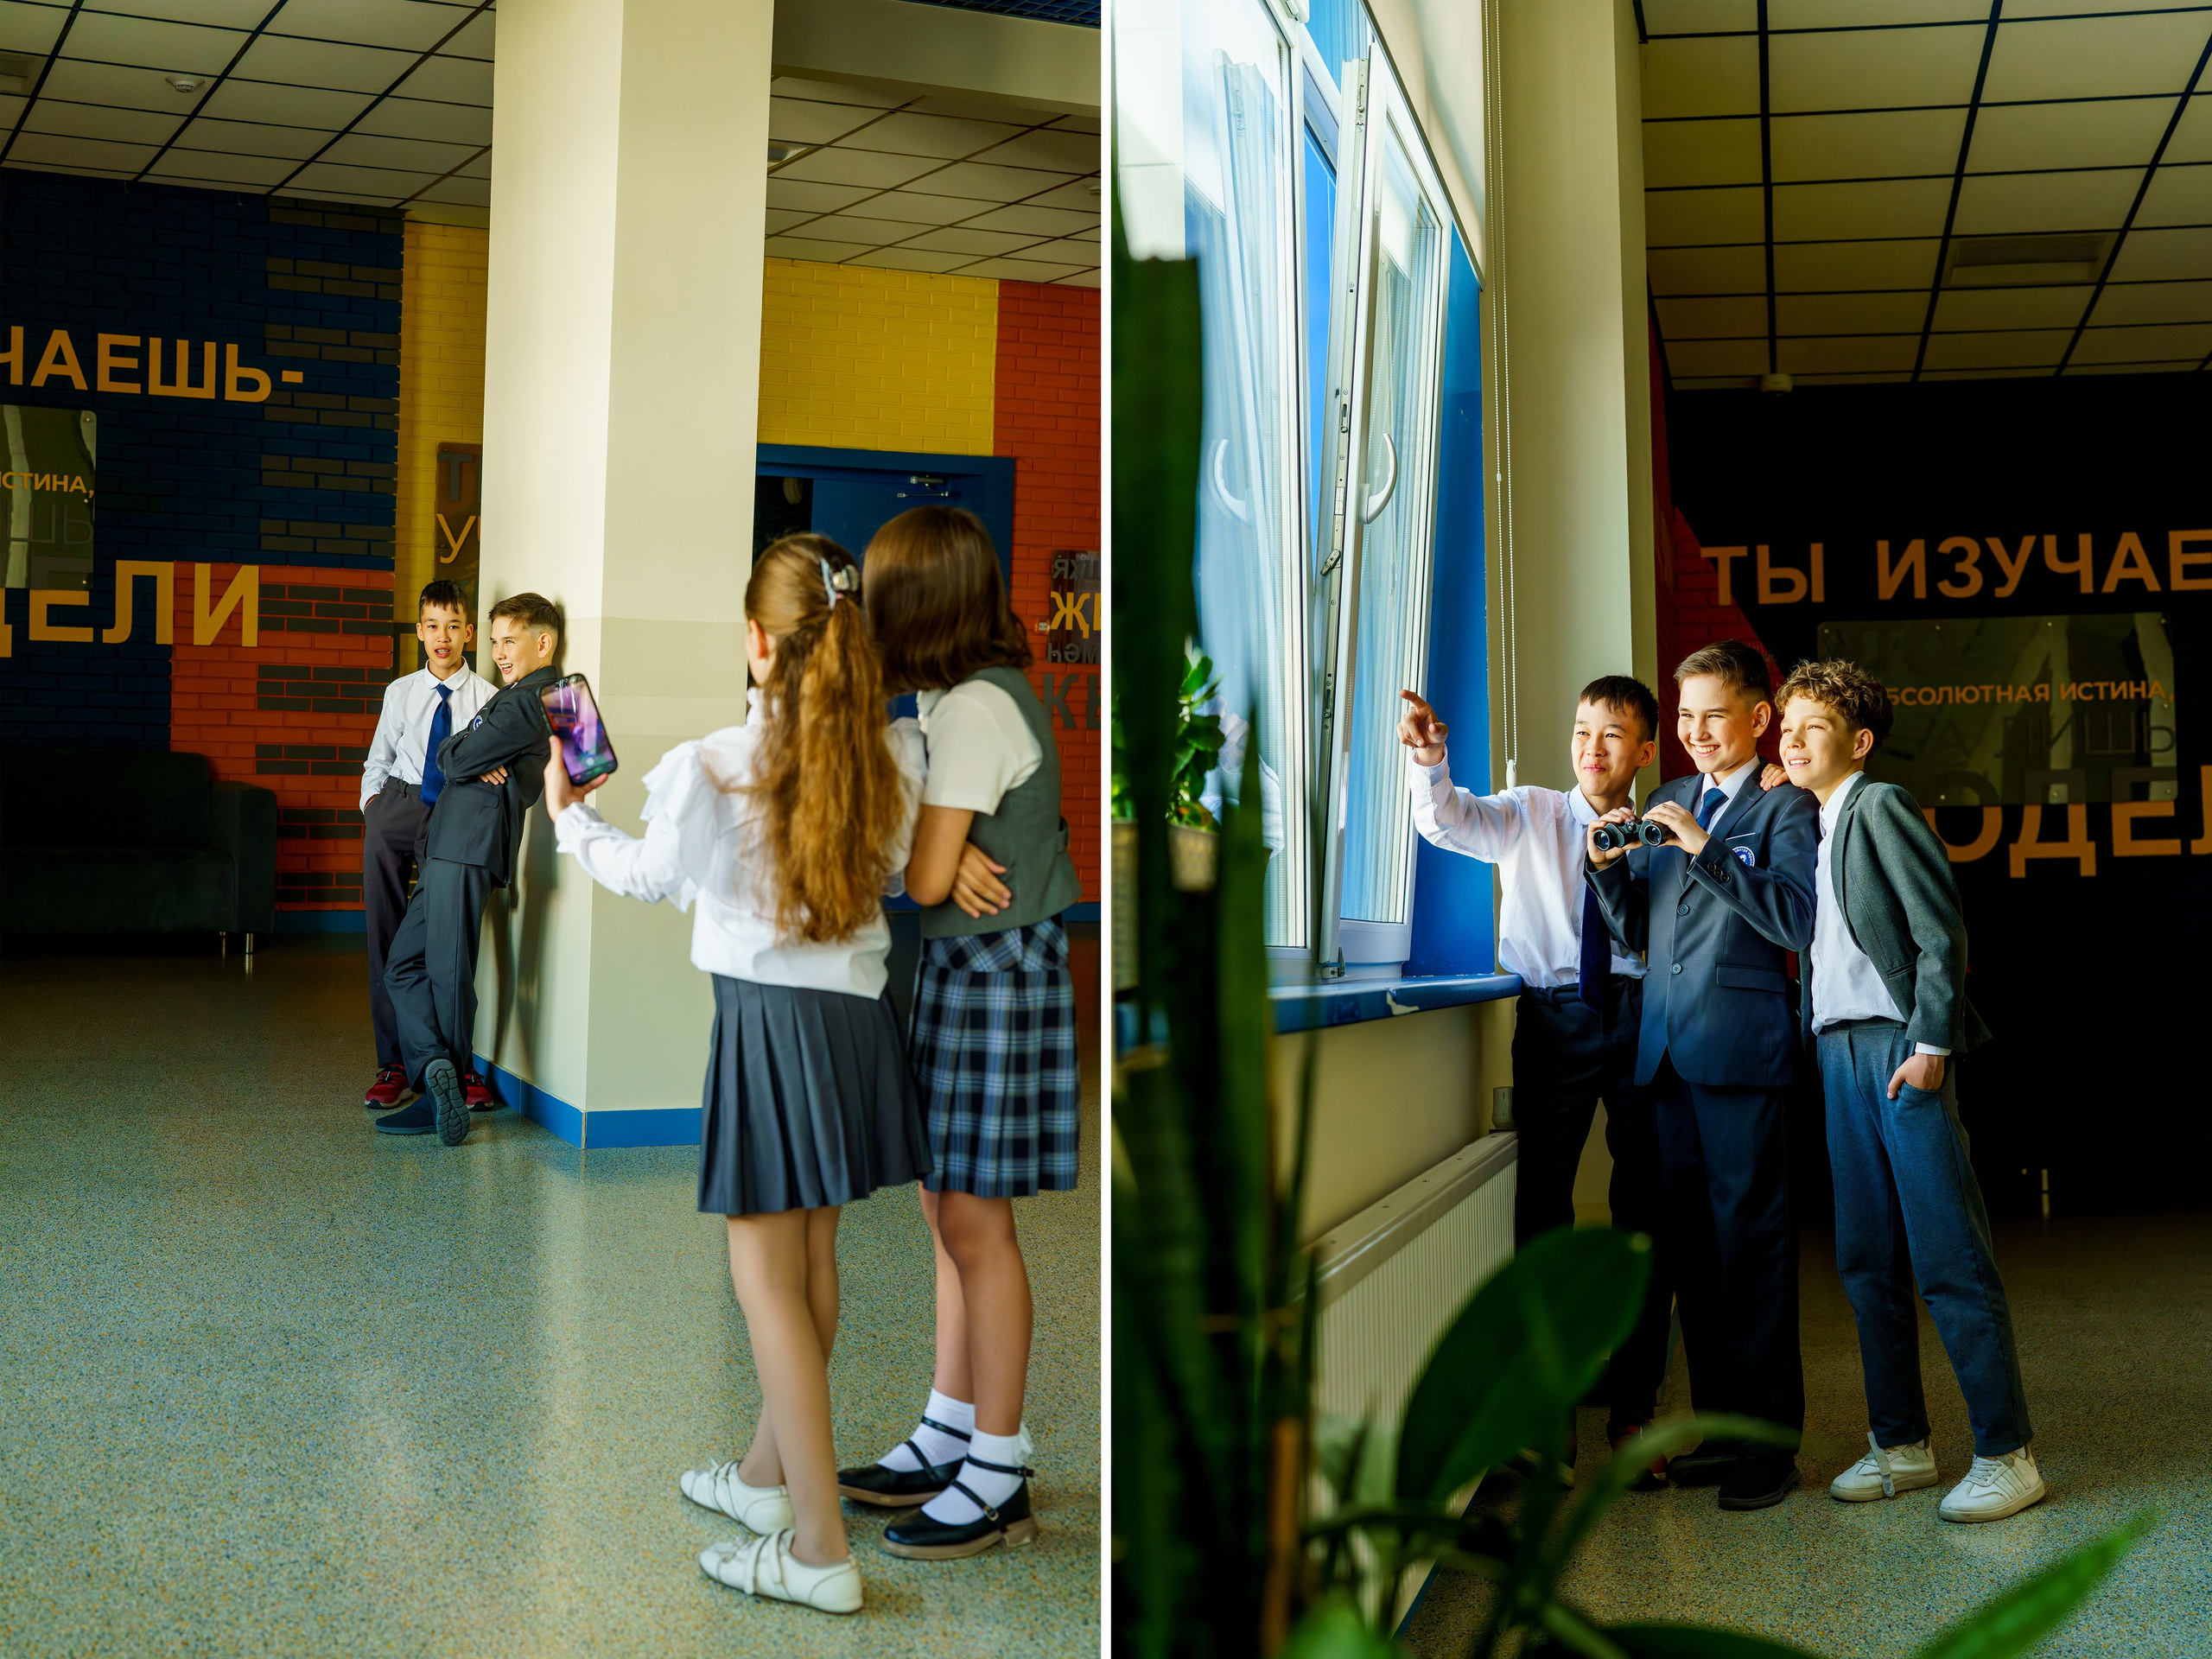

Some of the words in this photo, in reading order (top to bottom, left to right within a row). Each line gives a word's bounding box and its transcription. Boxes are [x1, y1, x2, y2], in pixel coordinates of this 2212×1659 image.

[0, 471, 94, 499] СТИНА,
[1700, 542, 1825, 607] ТЫ
[1876, 529, 2212, 601] ИЗУЧАЕ
[0, 556, 259, 658] ЕЛИ
[1886, 683, 2050, 707] БСОЛЮТНАЯ
[2059, 679, 2175, 702] ИСТИНА,
